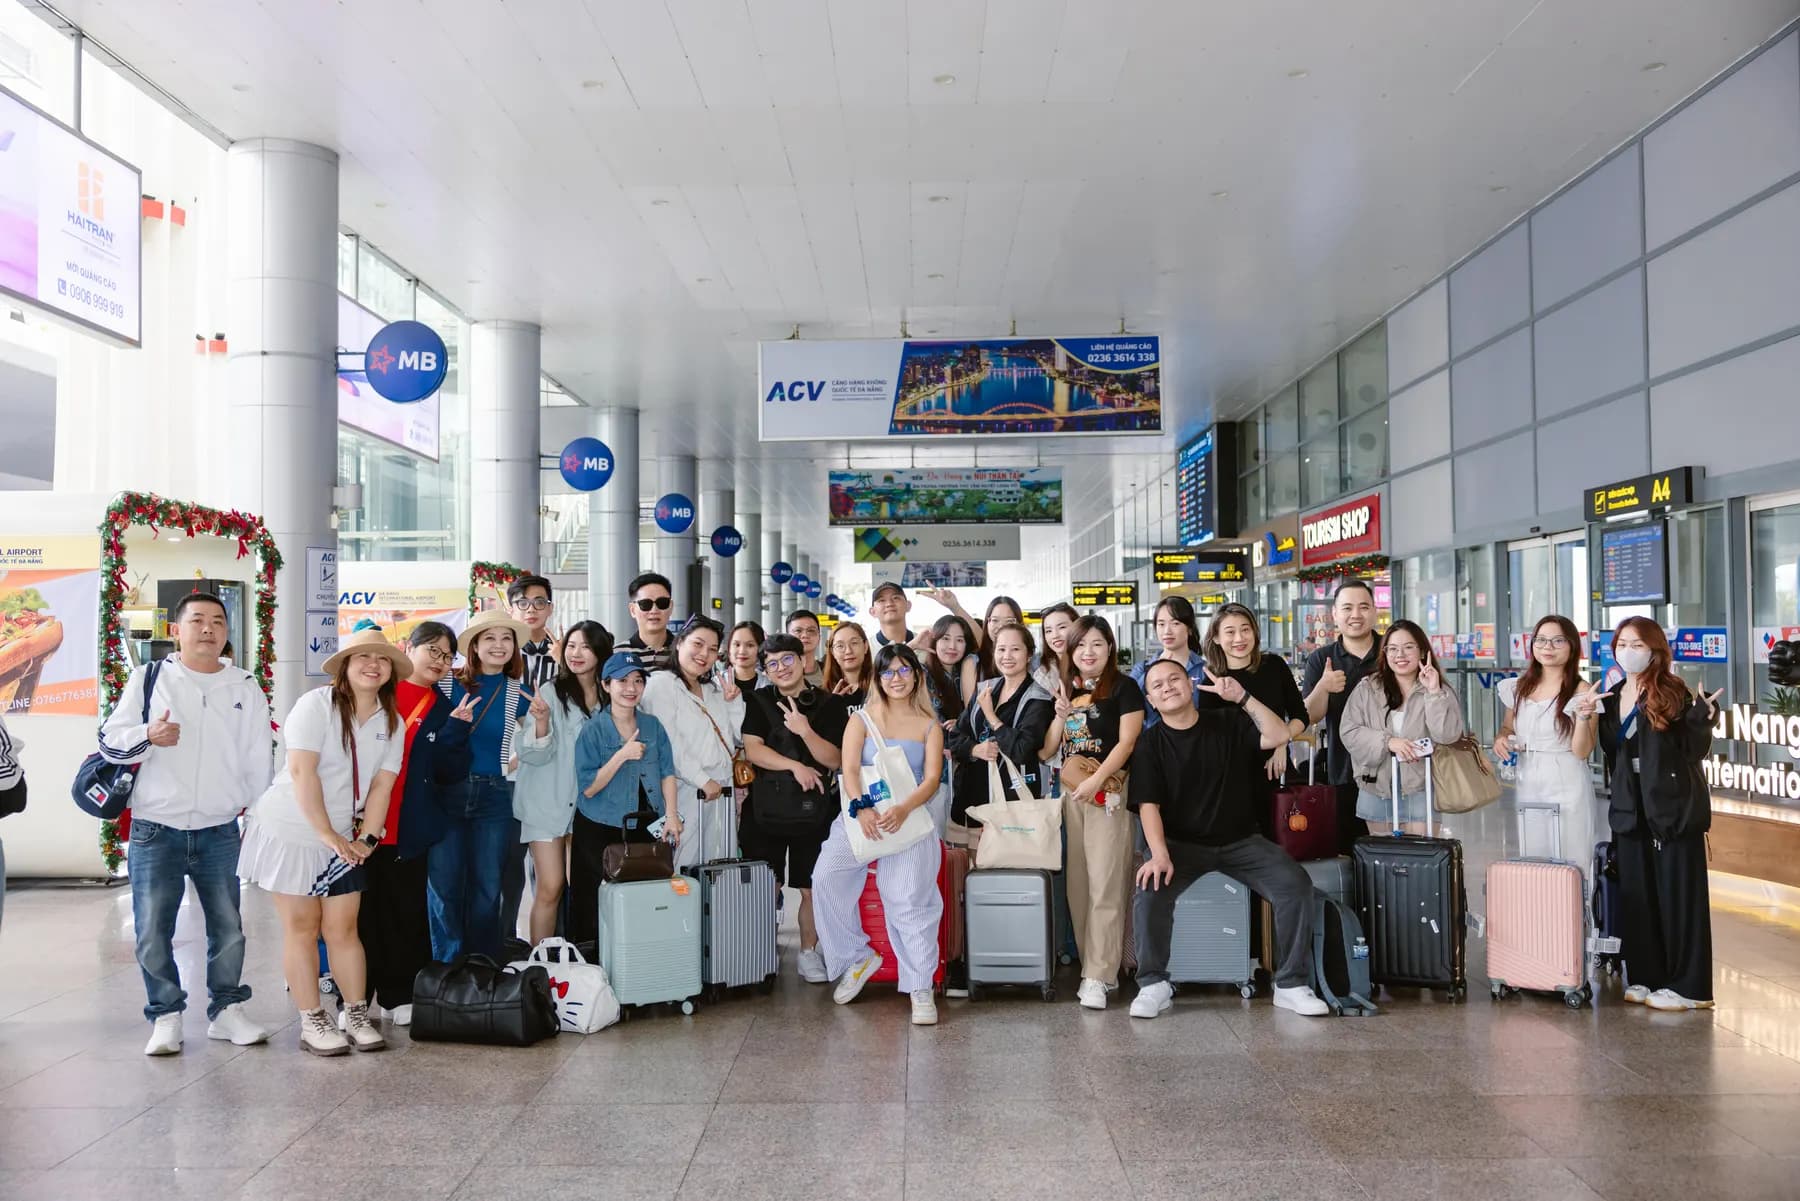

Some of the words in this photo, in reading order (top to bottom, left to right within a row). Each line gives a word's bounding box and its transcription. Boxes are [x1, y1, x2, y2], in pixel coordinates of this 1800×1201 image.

[69, 284, 92, 305] 0906
[92, 294, 109, 313] 999
[109, 300, 124, 319] 919
[398, 351, 437, 371] MB
[1088, 354, 1112, 363] 0236
[1113, 353, 1135, 362] 3614
[1137, 352, 1155, 361] 338
[766, 381, 826, 402] ACV
[583, 457, 609, 471] MB
[1652, 477, 1671, 503] A4
[671, 507, 691, 518] MB
[1302, 515, 1341, 549] TOURISM
[1341, 506, 1370, 540] SHOP
[724, 537, 740, 546] MB
[6, 548, 43, 556] AIRPORT
[338, 592, 376, 605] ACV
[1733, 703, 1800, 759] Nang
